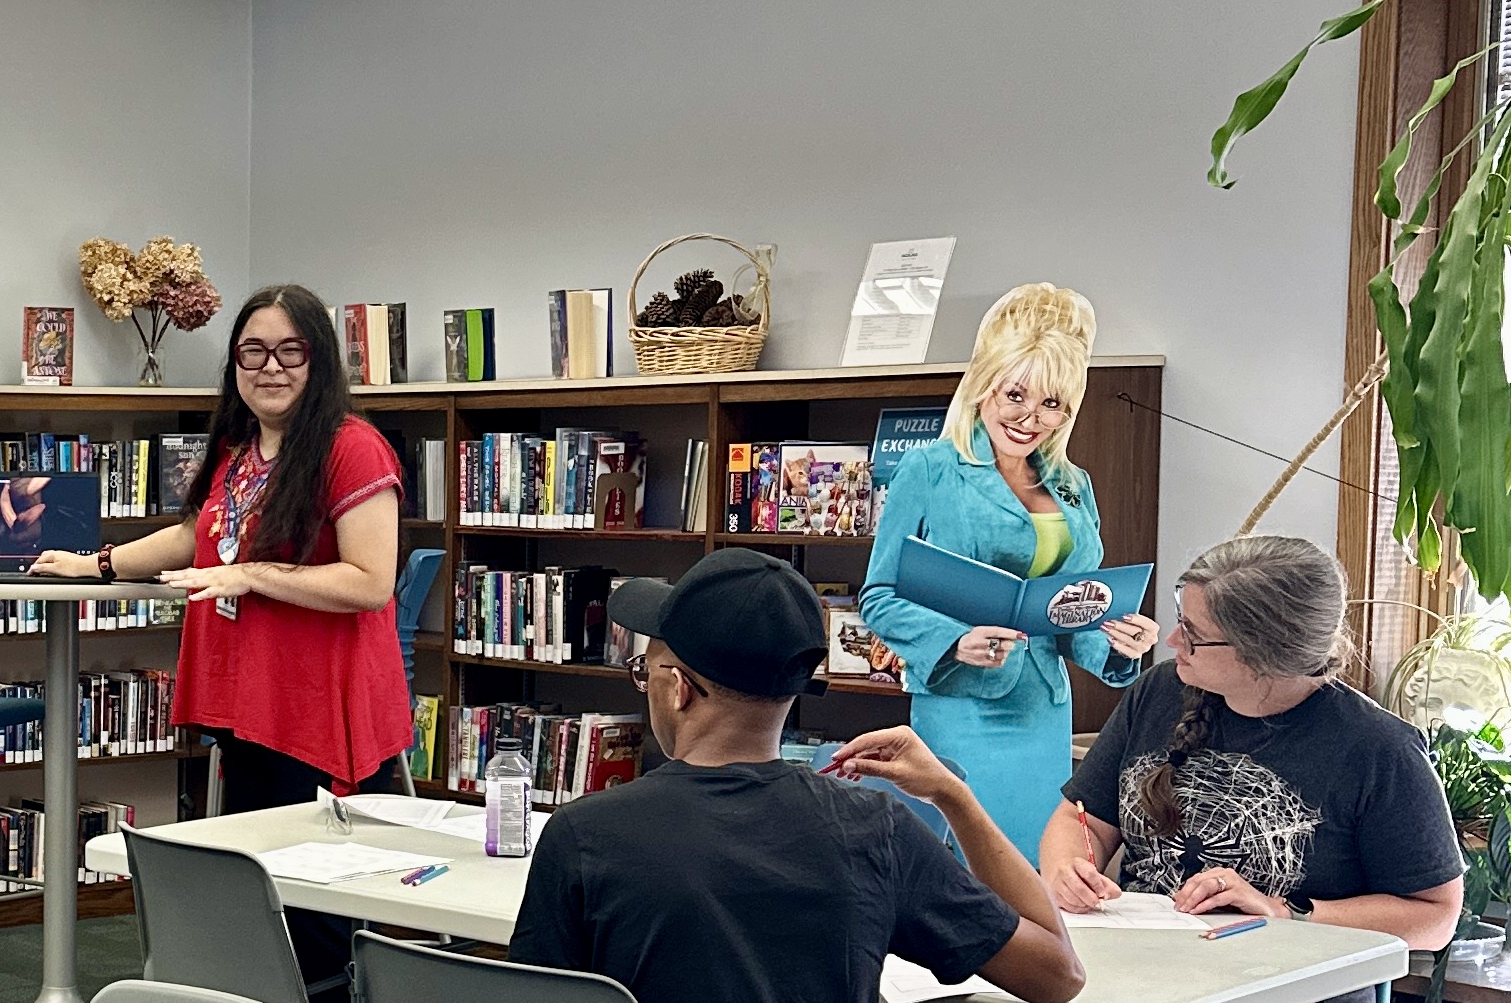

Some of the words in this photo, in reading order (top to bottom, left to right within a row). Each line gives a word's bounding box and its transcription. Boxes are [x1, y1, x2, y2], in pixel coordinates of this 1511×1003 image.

[894, 418, 940, 433] PUZZLE
[733, 472, 742, 505] KODAK
[728, 513, 739, 533] 350
